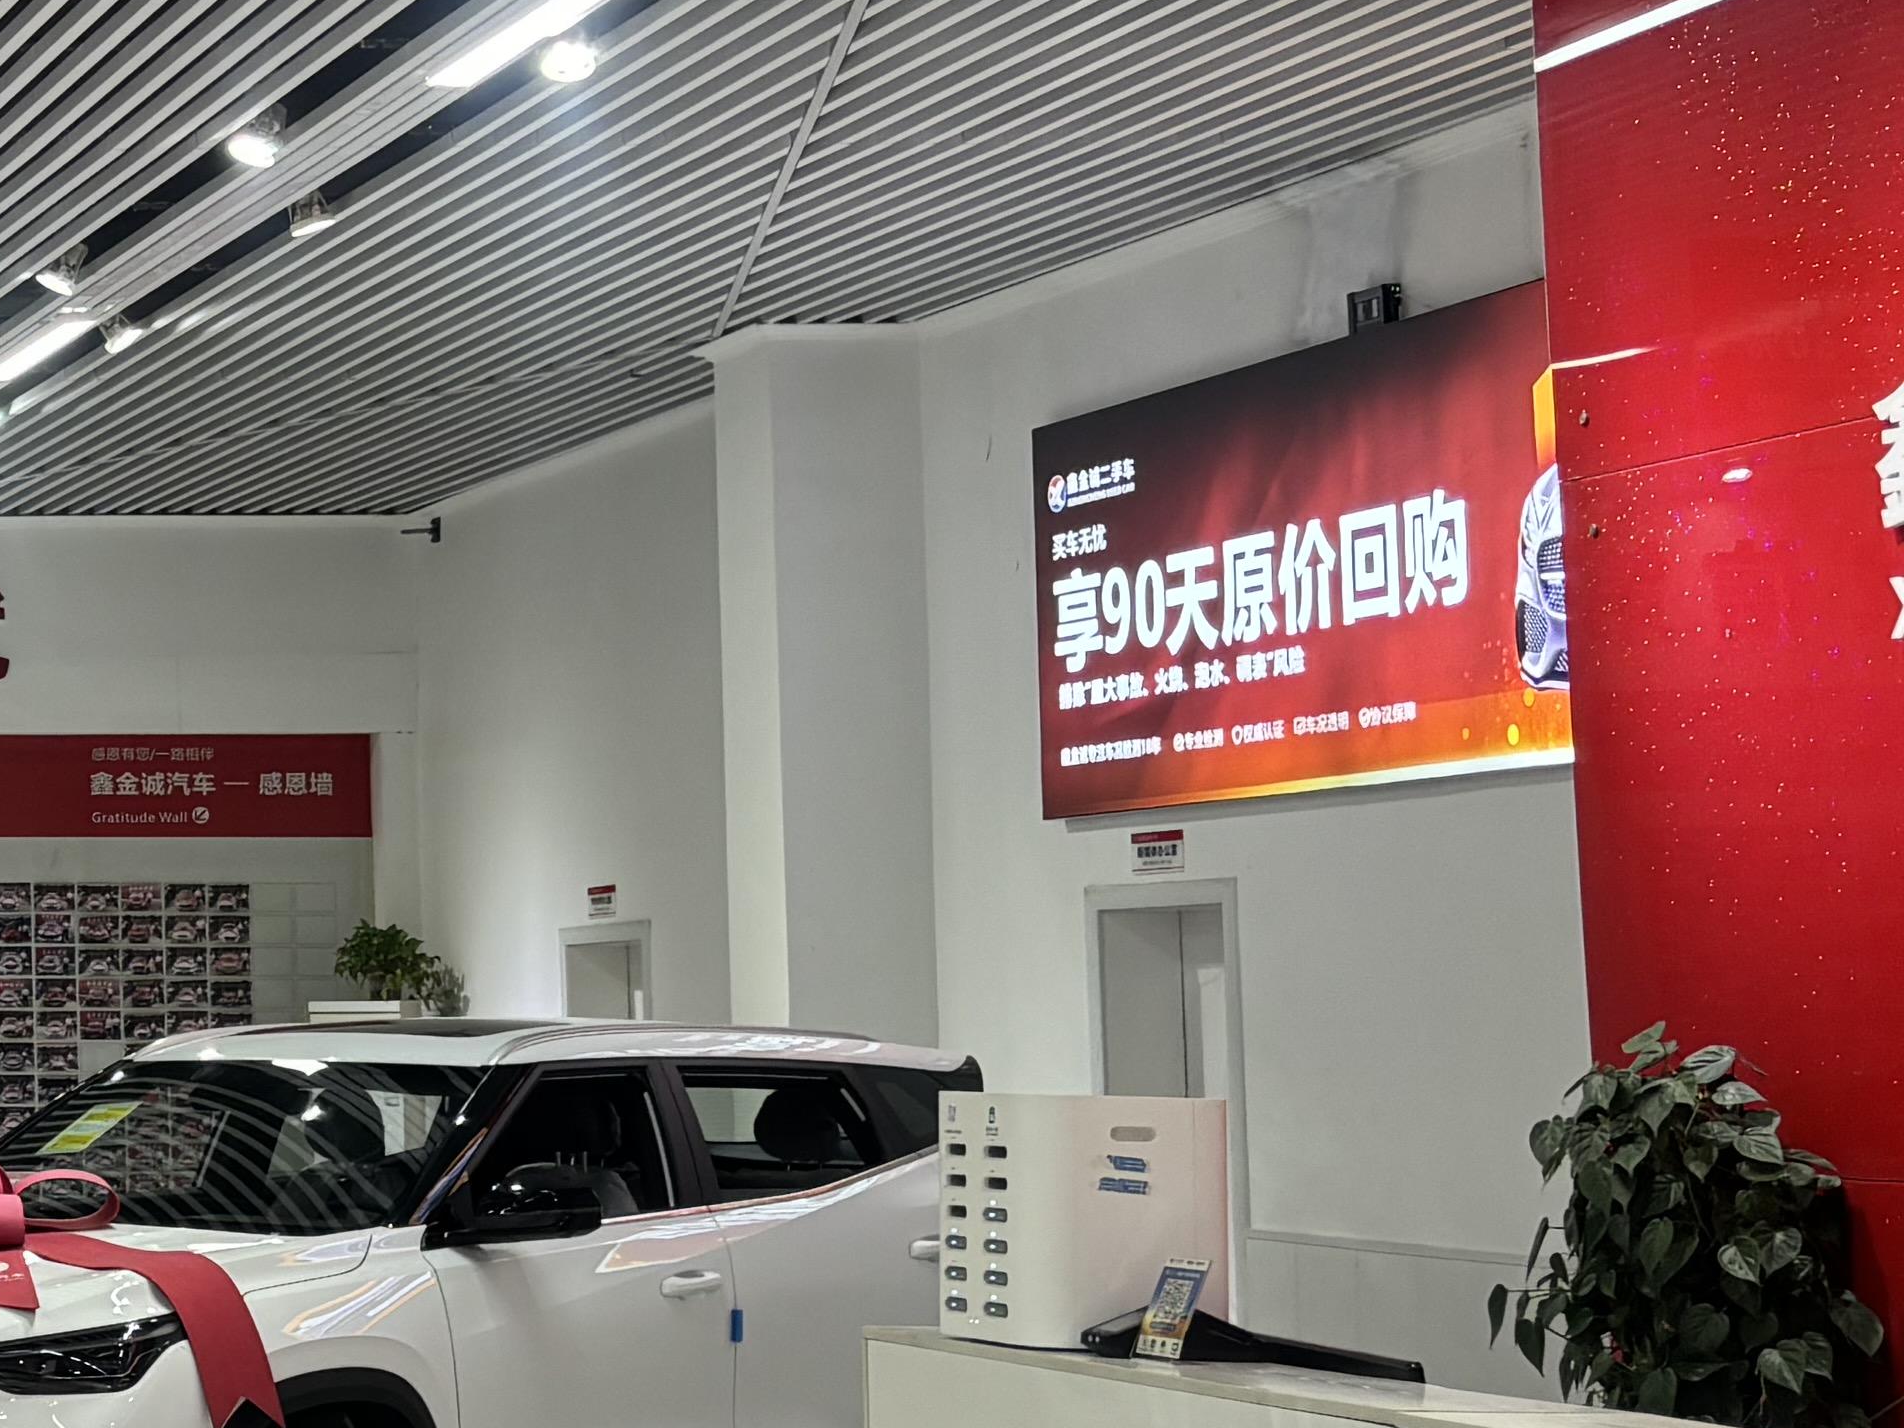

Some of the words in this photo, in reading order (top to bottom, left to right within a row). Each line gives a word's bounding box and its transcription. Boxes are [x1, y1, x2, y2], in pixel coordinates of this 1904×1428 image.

[1052, 524, 1107, 561] 买车无忧
[1052, 487, 1469, 674] 享90天原价回购
[90, 772, 216, 796] 鑫金诚汽车
[259, 772, 334, 796] 感恩墙
[92, 810, 155, 823] Gratitude
[159, 810, 188, 823] Wall
